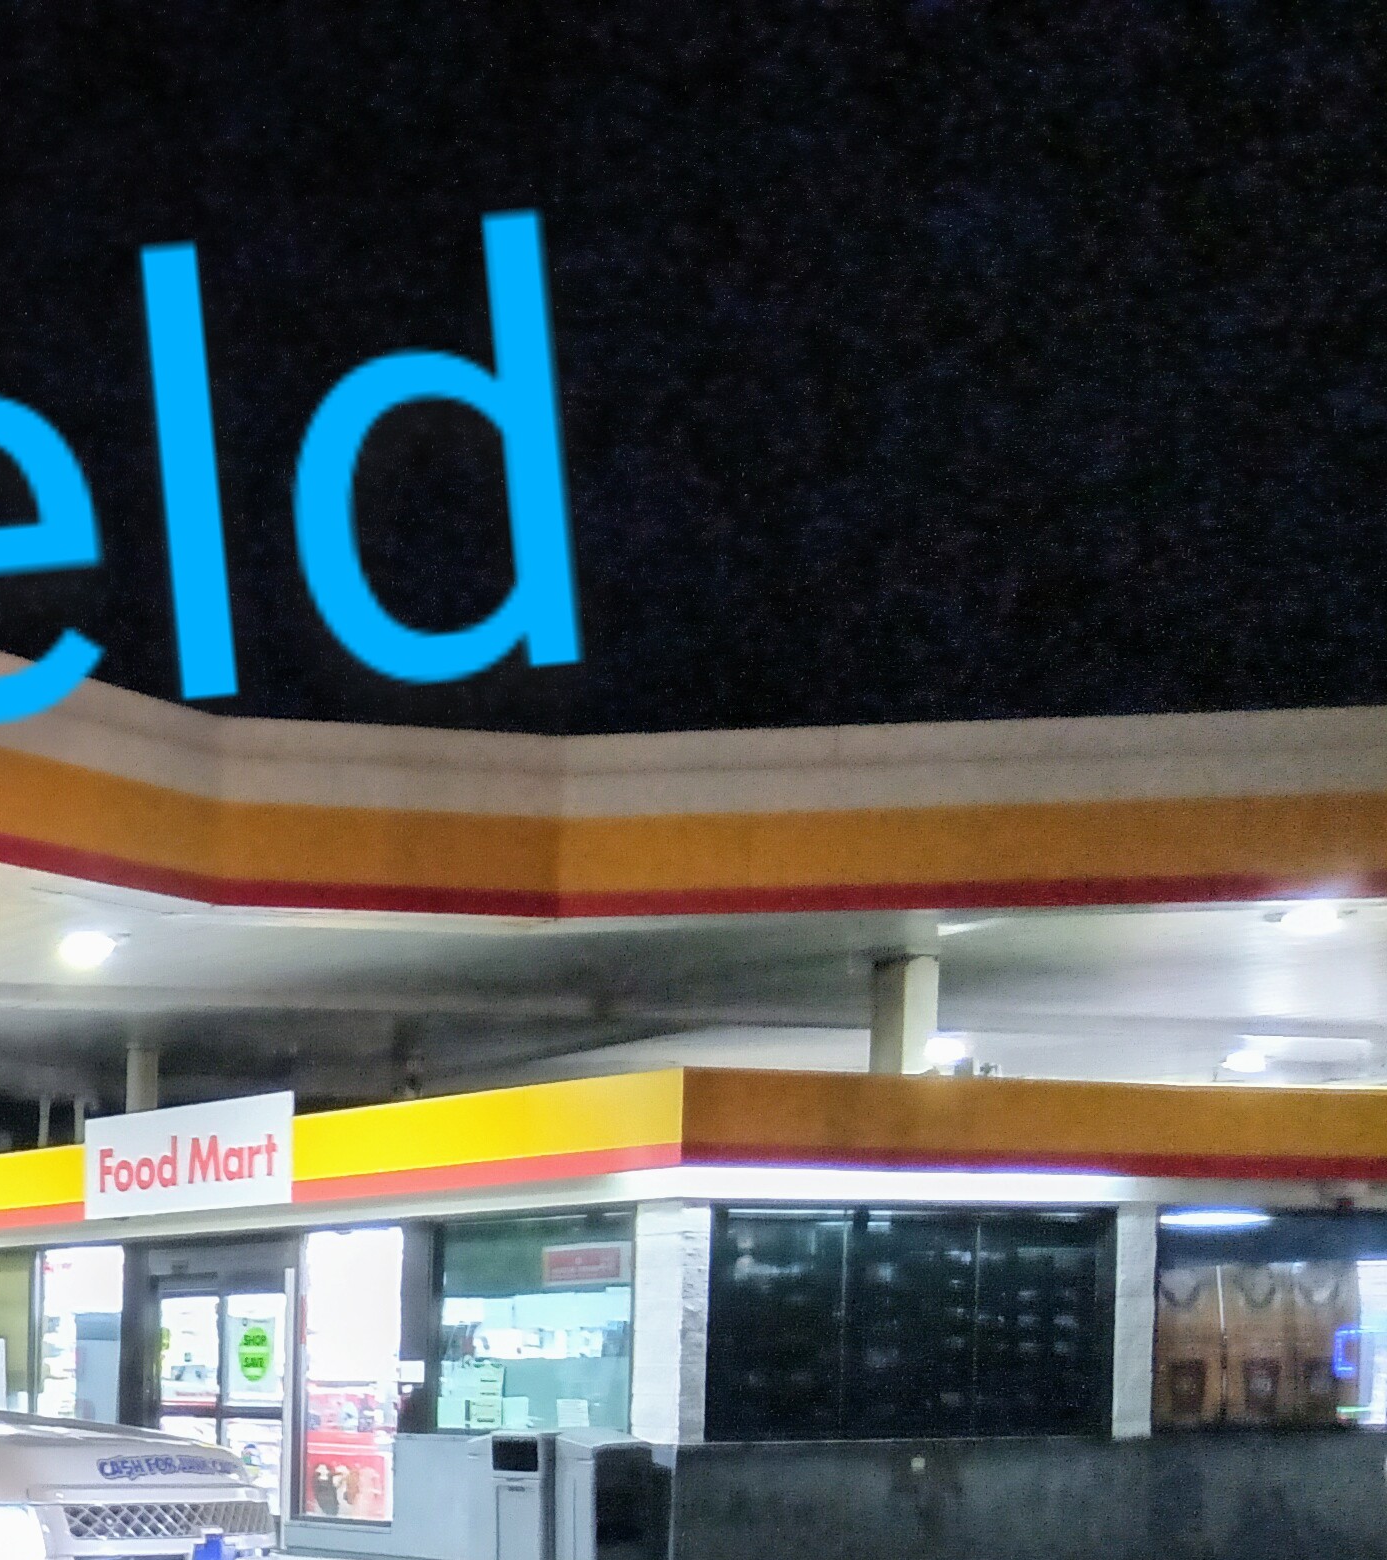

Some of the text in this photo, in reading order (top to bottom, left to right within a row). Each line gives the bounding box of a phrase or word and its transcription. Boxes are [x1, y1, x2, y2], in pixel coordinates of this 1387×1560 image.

[99, 1133, 277, 1193] Food Mart
[243, 1334, 267, 1346] SHOP
